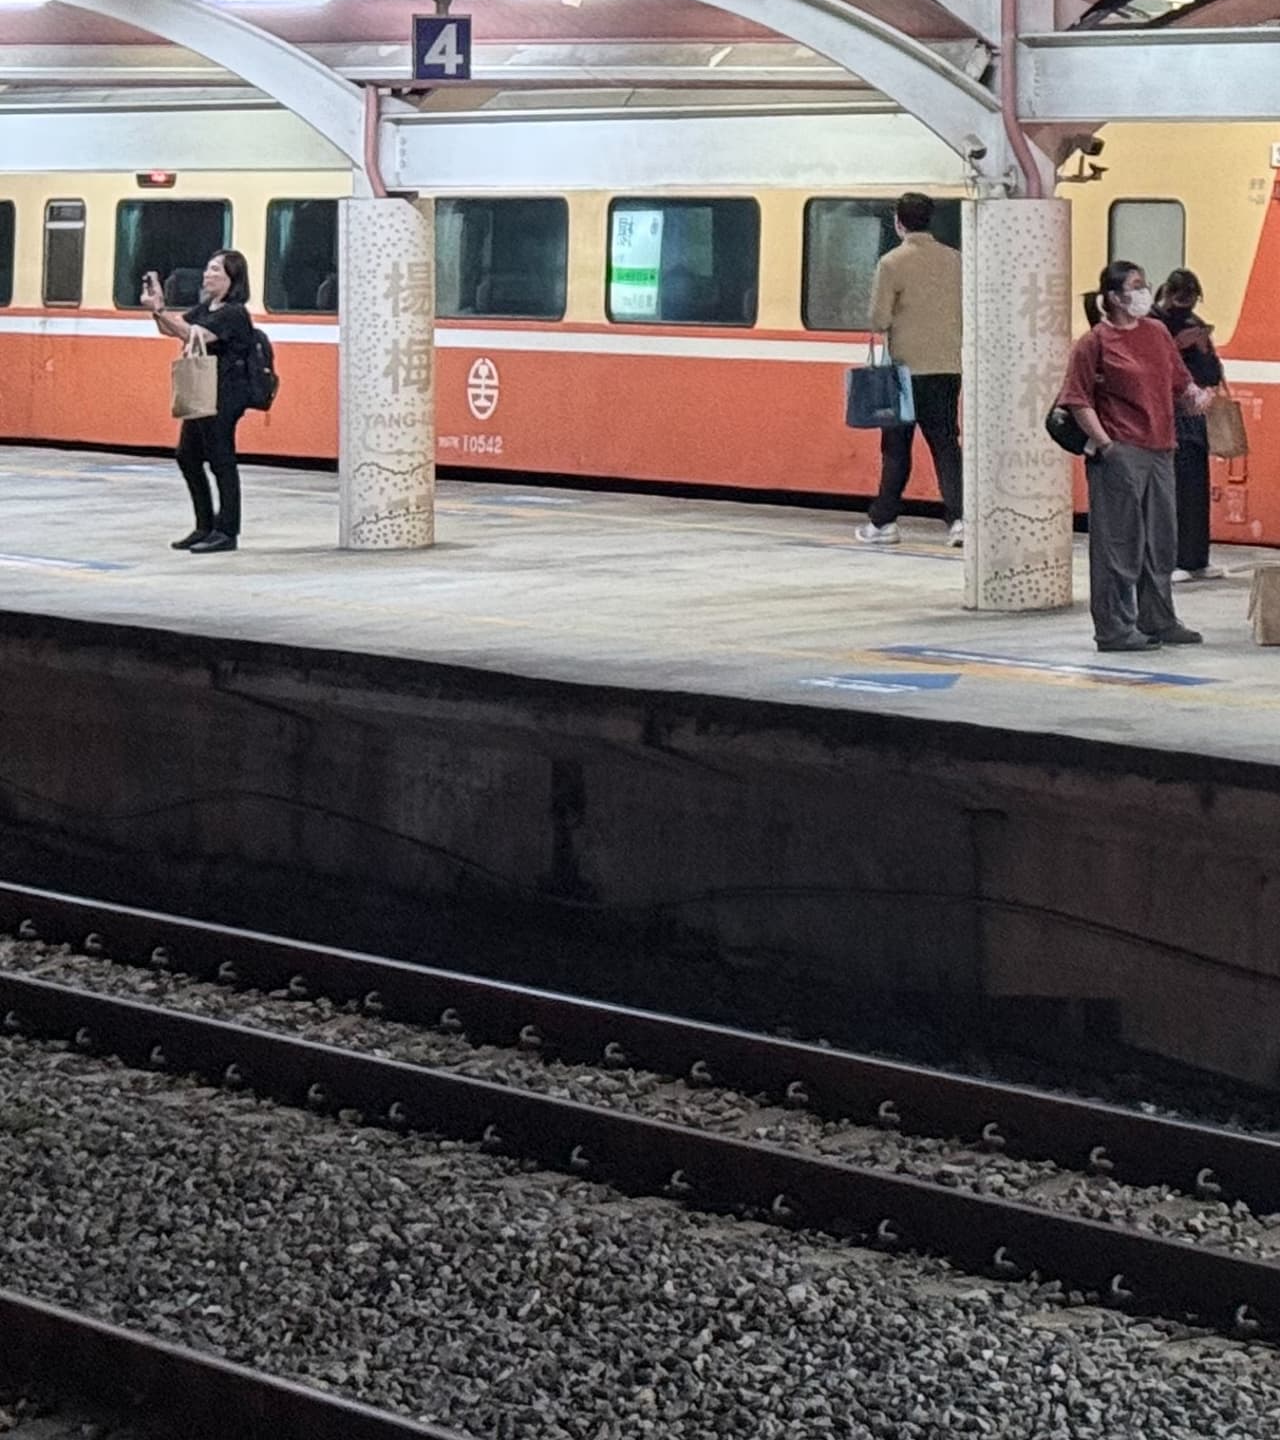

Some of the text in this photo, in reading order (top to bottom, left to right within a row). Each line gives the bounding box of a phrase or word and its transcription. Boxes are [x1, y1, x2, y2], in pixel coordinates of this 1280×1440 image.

[423, 22, 464, 75] 4
[382, 260, 433, 394] 楊梅
[462, 434, 503, 454] 10542
